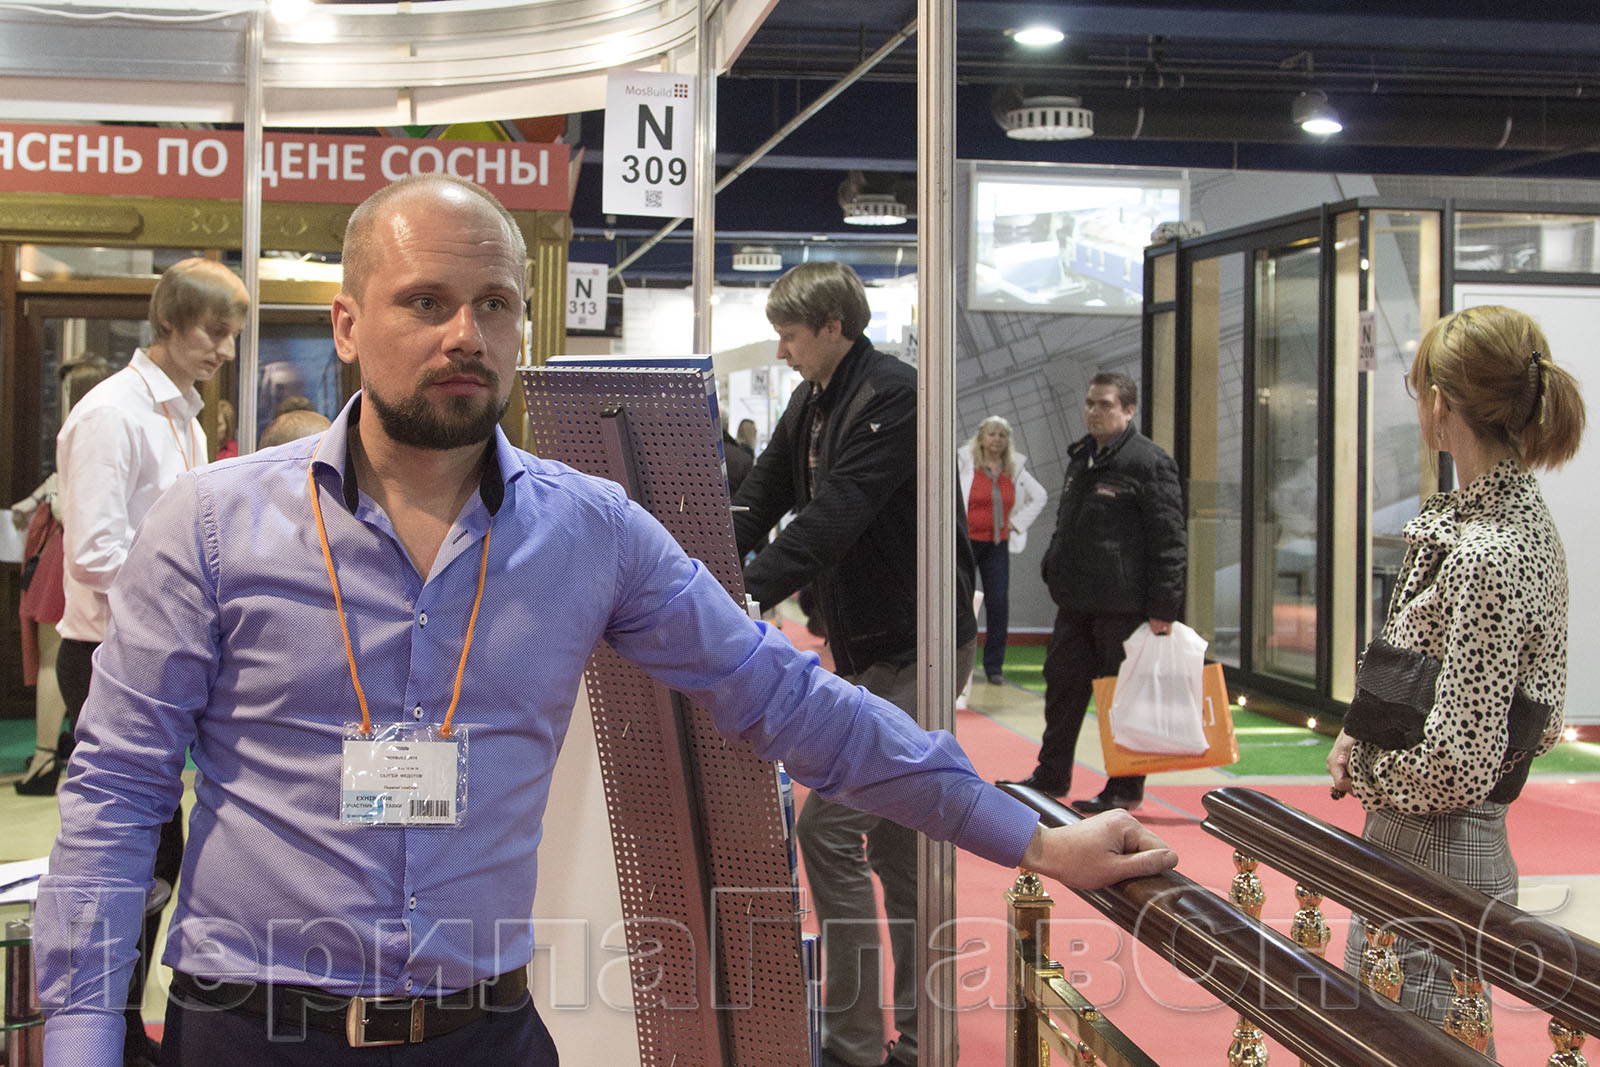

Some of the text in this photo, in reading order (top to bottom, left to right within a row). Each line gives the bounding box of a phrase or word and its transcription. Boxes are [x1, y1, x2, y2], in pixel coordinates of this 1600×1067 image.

[625, 85, 672, 98] MosBuild
[637, 104, 674, 151] N
[157, 137, 228, 177] ПО
[381, 145, 549, 186] СОСНЫ
[622, 154, 688, 186] 309
[575, 278, 592, 298] N
[569, 300, 597, 315] 313
